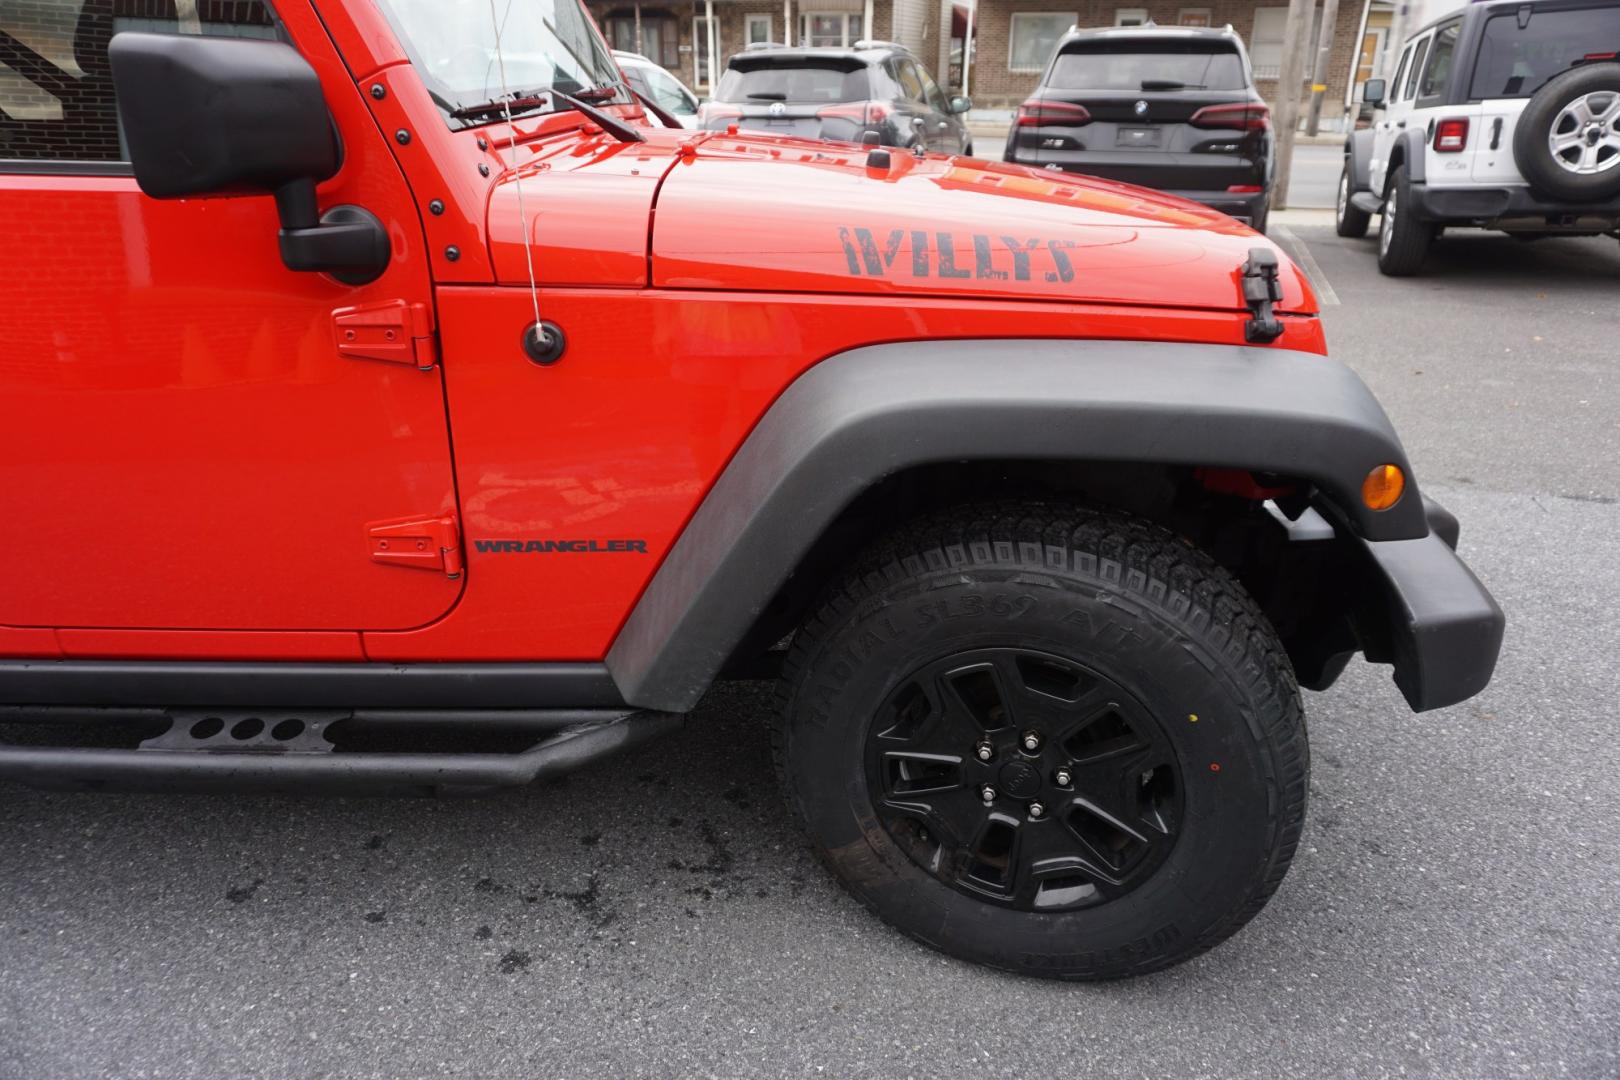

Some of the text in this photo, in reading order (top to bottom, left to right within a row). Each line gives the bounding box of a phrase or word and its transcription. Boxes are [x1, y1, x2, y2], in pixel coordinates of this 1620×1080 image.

[838, 227, 1076, 282] WILLYS
[474, 540, 648, 553] WRANGLER
[913, 593, 1039, 628] SL369
